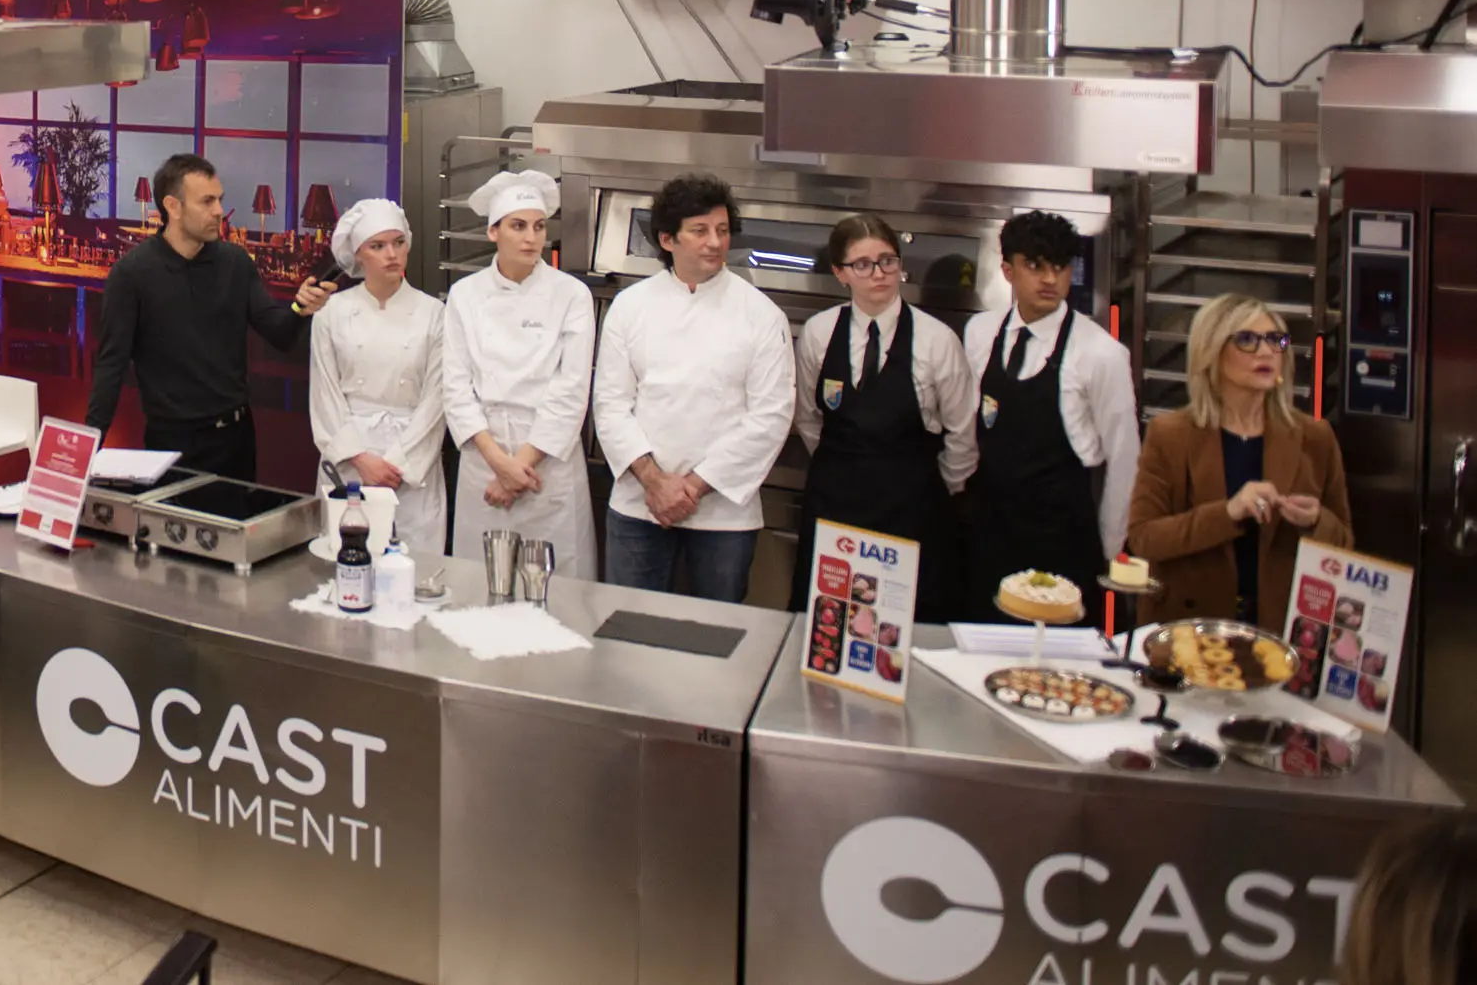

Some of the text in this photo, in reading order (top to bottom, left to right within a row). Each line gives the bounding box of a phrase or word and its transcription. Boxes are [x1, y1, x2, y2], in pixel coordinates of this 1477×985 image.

[859, 540, 899, 565] IAB
[1345, 563, 1390, 592] IAB
[150, 687, 387, 809] CAST
[153, 769, 383, 868] ALIMENTI
